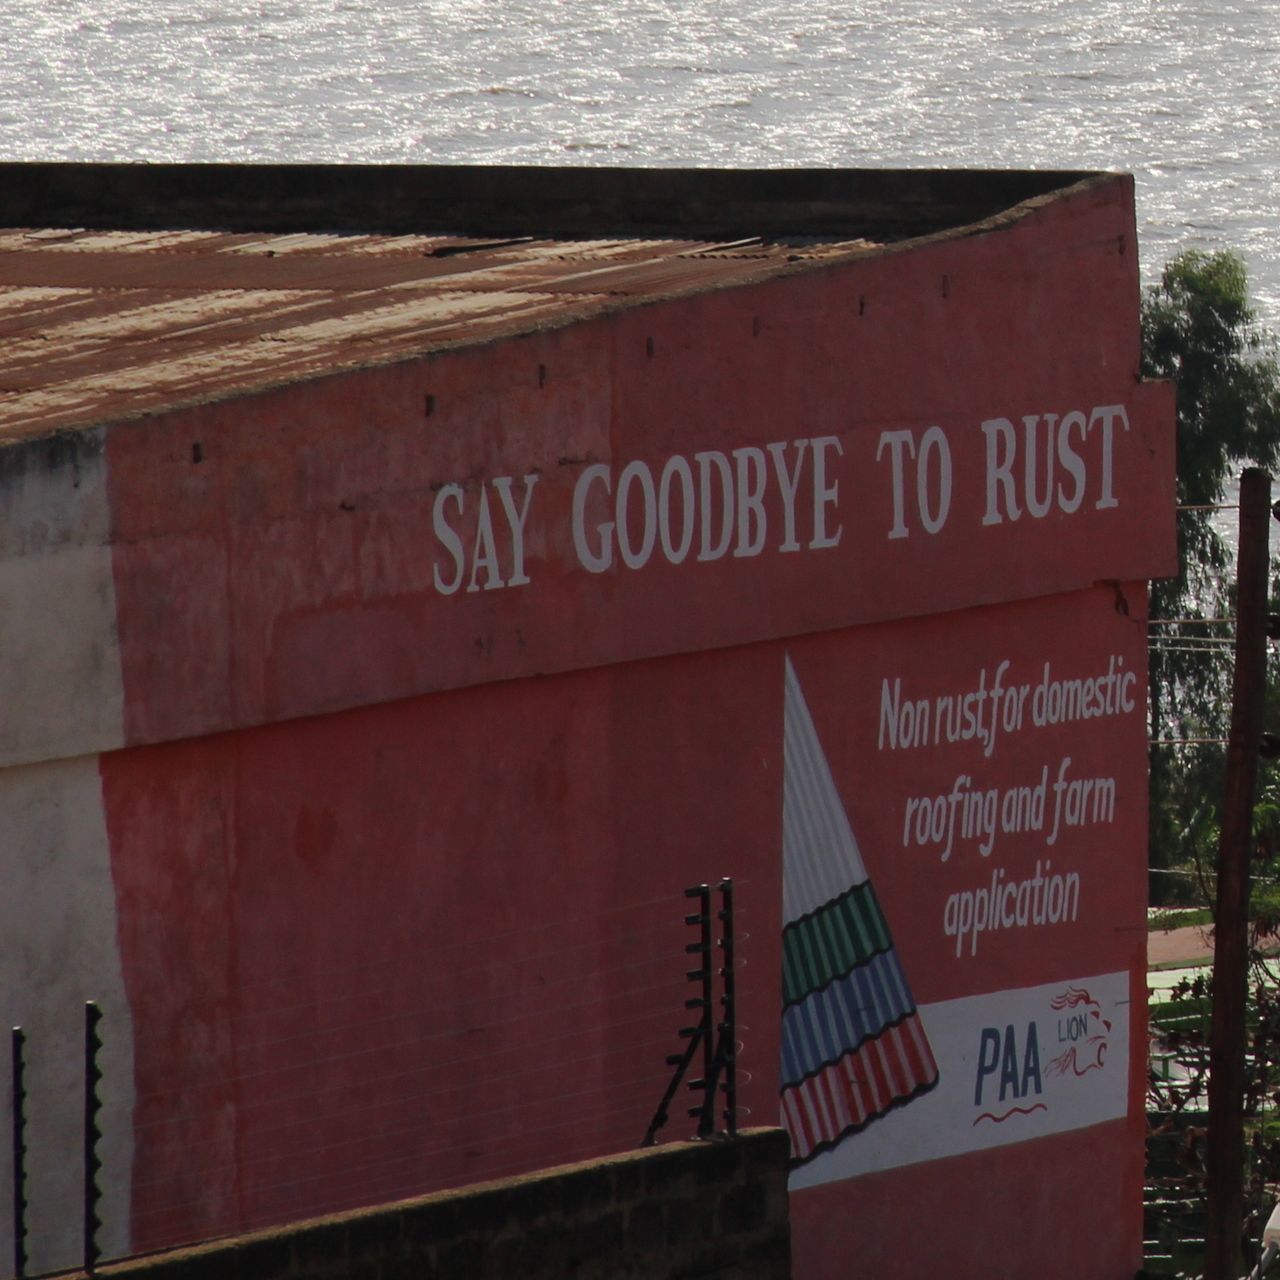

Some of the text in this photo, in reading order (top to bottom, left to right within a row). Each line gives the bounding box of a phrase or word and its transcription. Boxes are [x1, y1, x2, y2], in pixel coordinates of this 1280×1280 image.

[433, 404, 1130, 596] SAY GOODBYE TO RUST
[878, 677, 930, 750] Non
[984, 659, 1031, 758] for
[1032, 654, 1137, 727] domestic
[903, 757, 1116, 862] roofing and farm
[943, 859, 1080, 958] application
[973, 1020, 1043, 1107] PAA
[1057, 1013, 1088, 1043] LION
